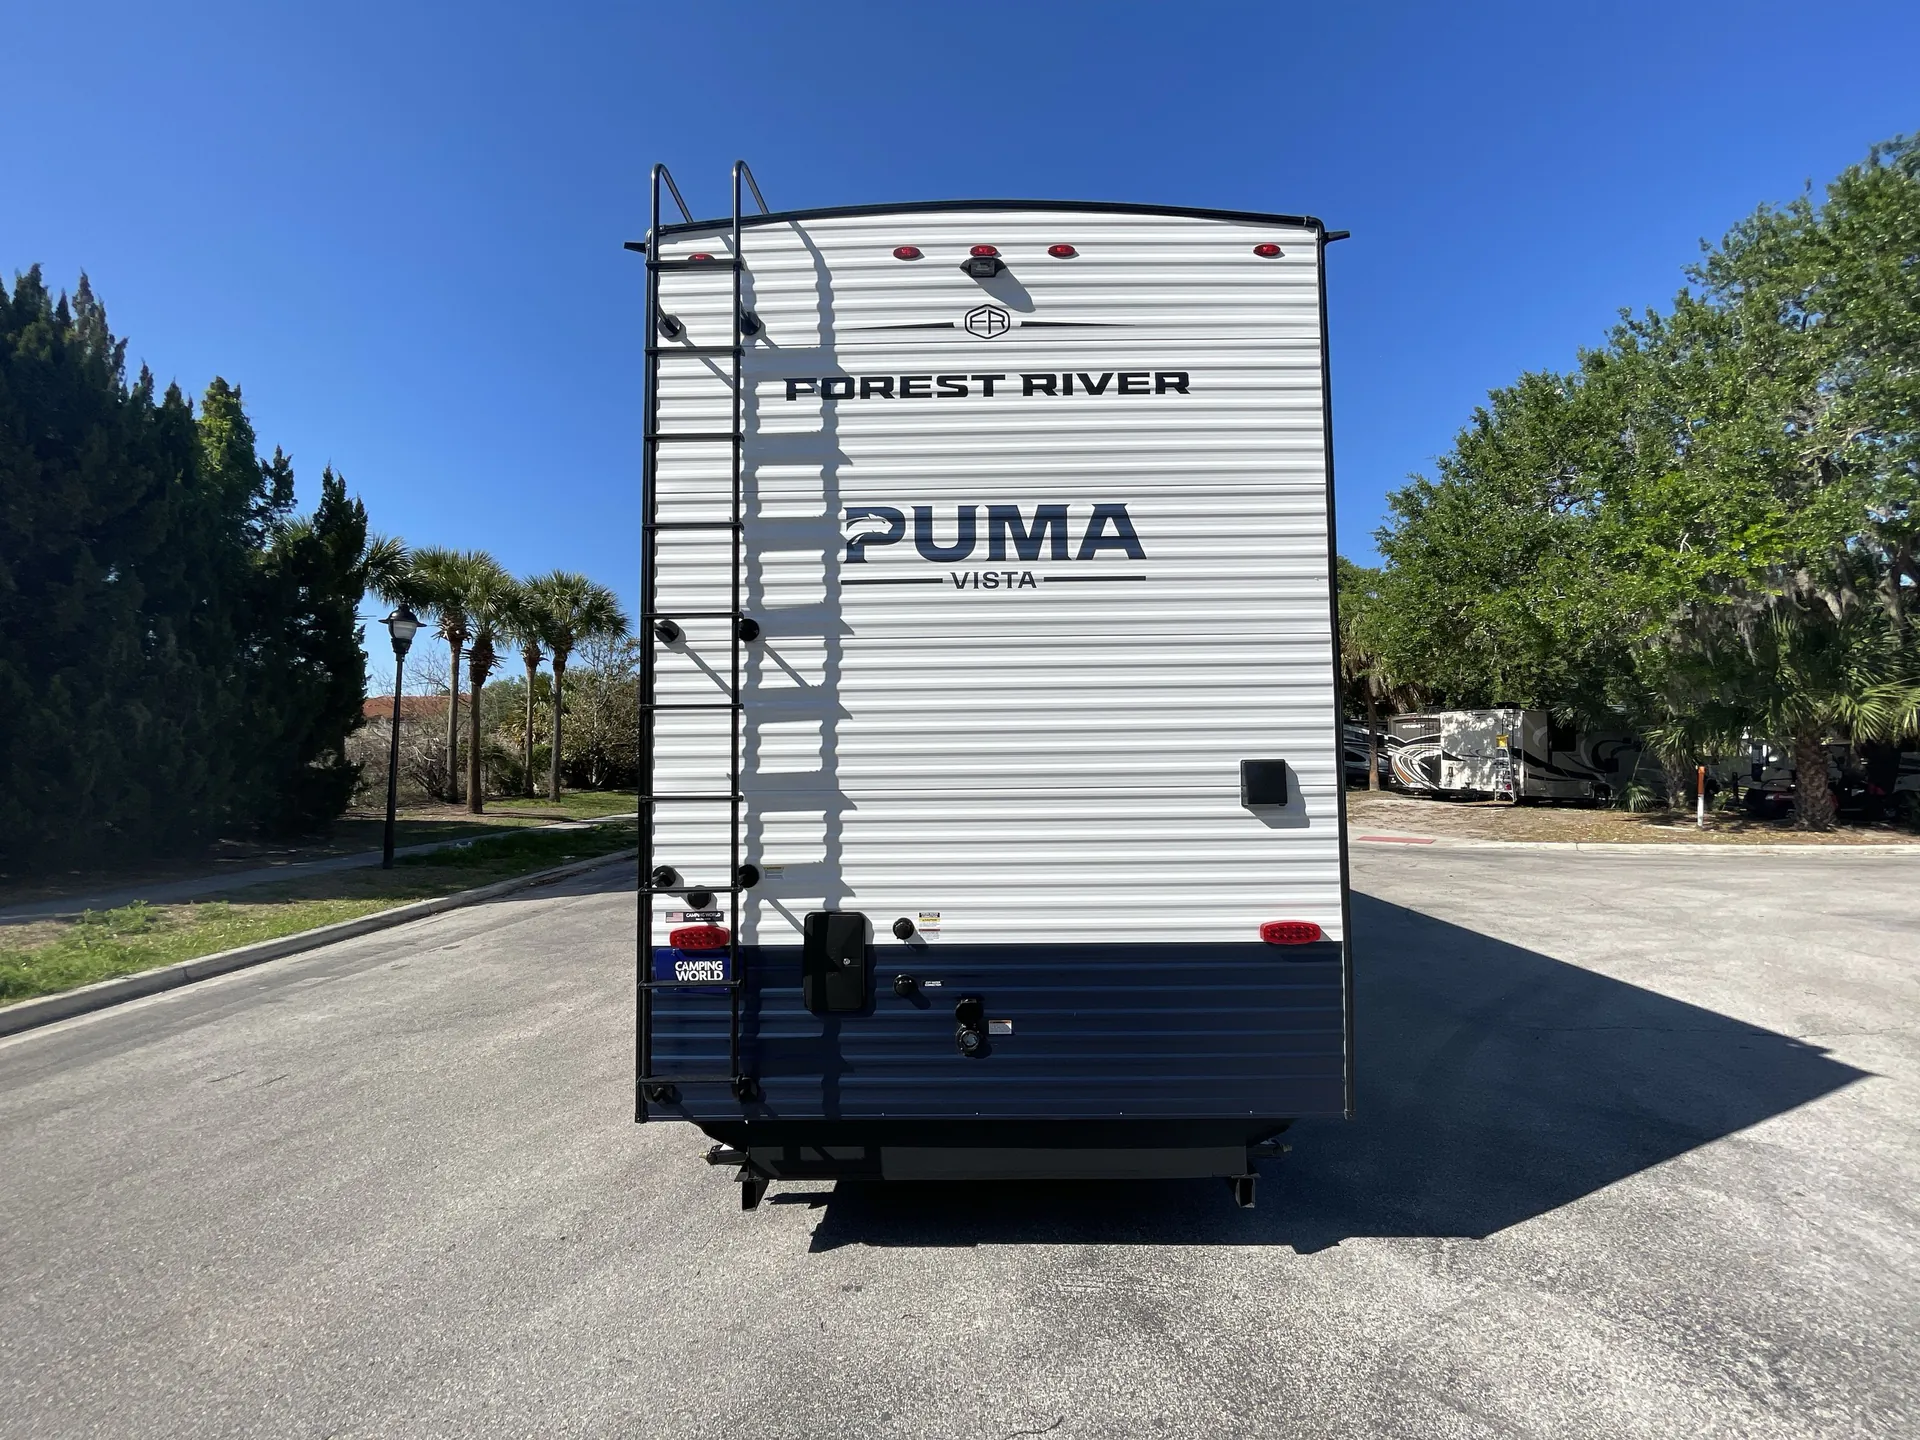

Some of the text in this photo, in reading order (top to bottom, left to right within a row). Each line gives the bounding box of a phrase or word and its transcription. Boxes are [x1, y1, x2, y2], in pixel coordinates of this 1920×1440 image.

[969, 309, 1006, 335] FR
[782, 371, 1192, 401] FOREST RIVER
[840, 502, 1148, 564] PUMA
[950, 570, 1038, 590] VISTA
[675, 961, 723, 971] CAMPING
[676, 970, 723, 981] WORLD
